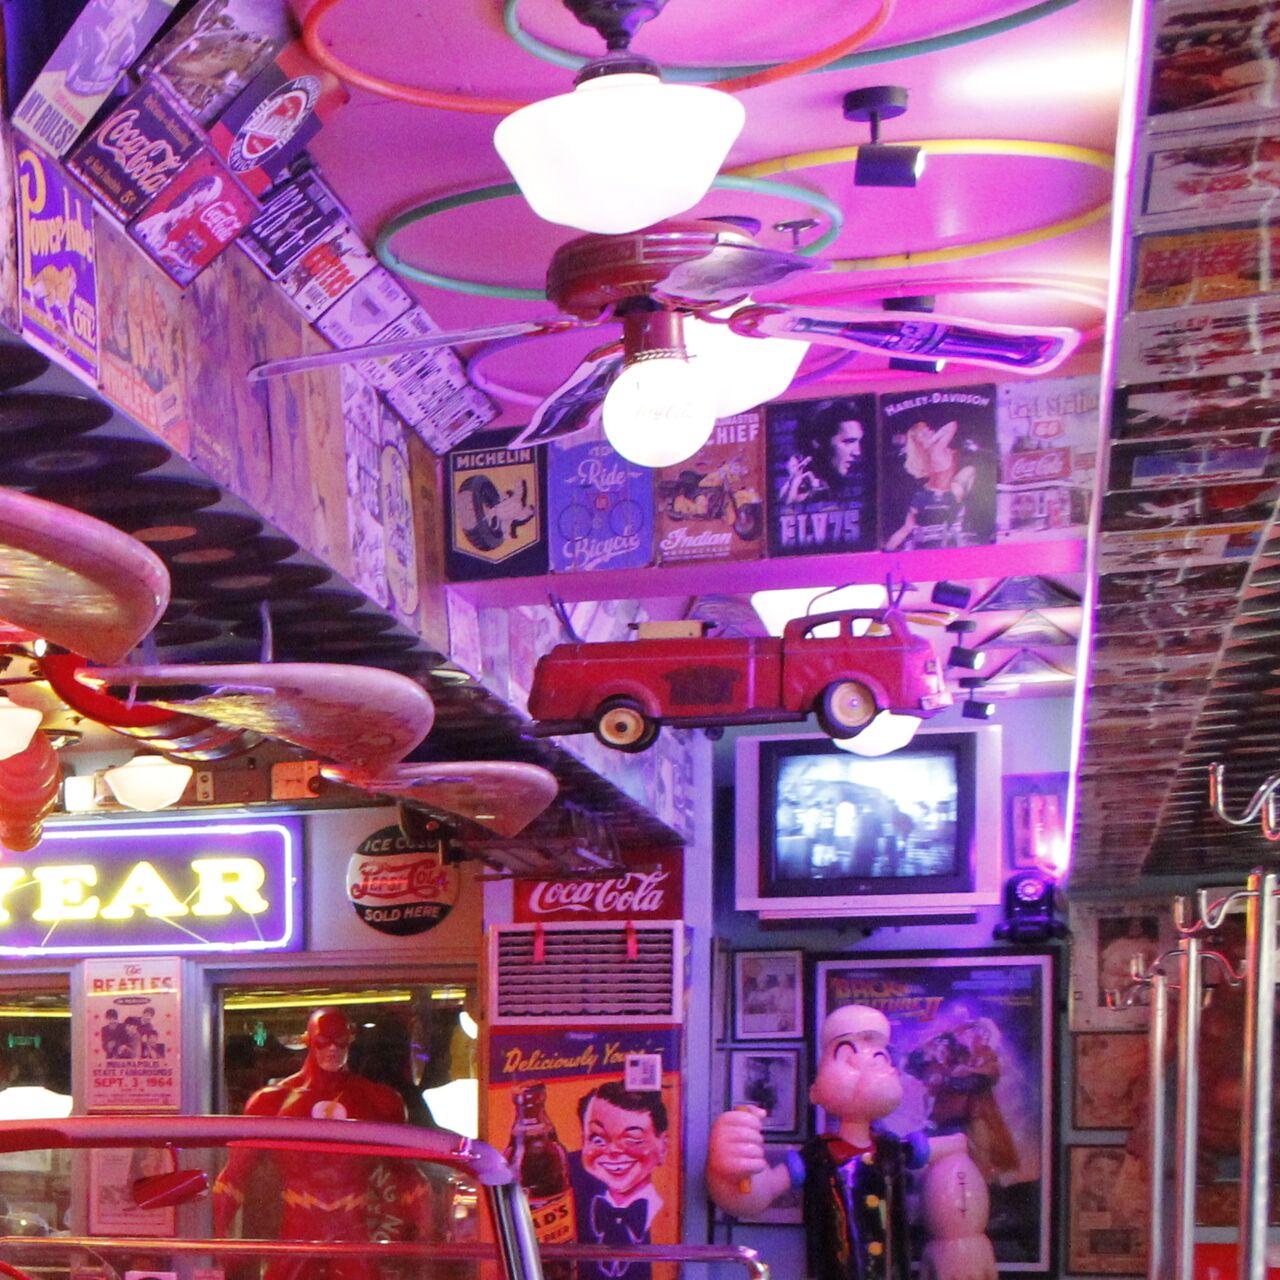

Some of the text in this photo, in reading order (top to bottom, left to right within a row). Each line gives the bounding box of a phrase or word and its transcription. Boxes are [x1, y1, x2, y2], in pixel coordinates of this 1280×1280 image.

[884, 392, 990, 416] HARLEY-DAVIDSON
[456, 450, 531, 469] MICHELIN
[577, 460, 626, 491] Ride
[660, 528, 733, 551] Indian
[364, 838, 391, 852] ICE
[364, 905, 440, 923] SOLD HERE
[92, 976, 172, 994] BEATLES
[502, 1042, 597, 1073] Deliciously
[146, 1077, 173, 1087] 1964
